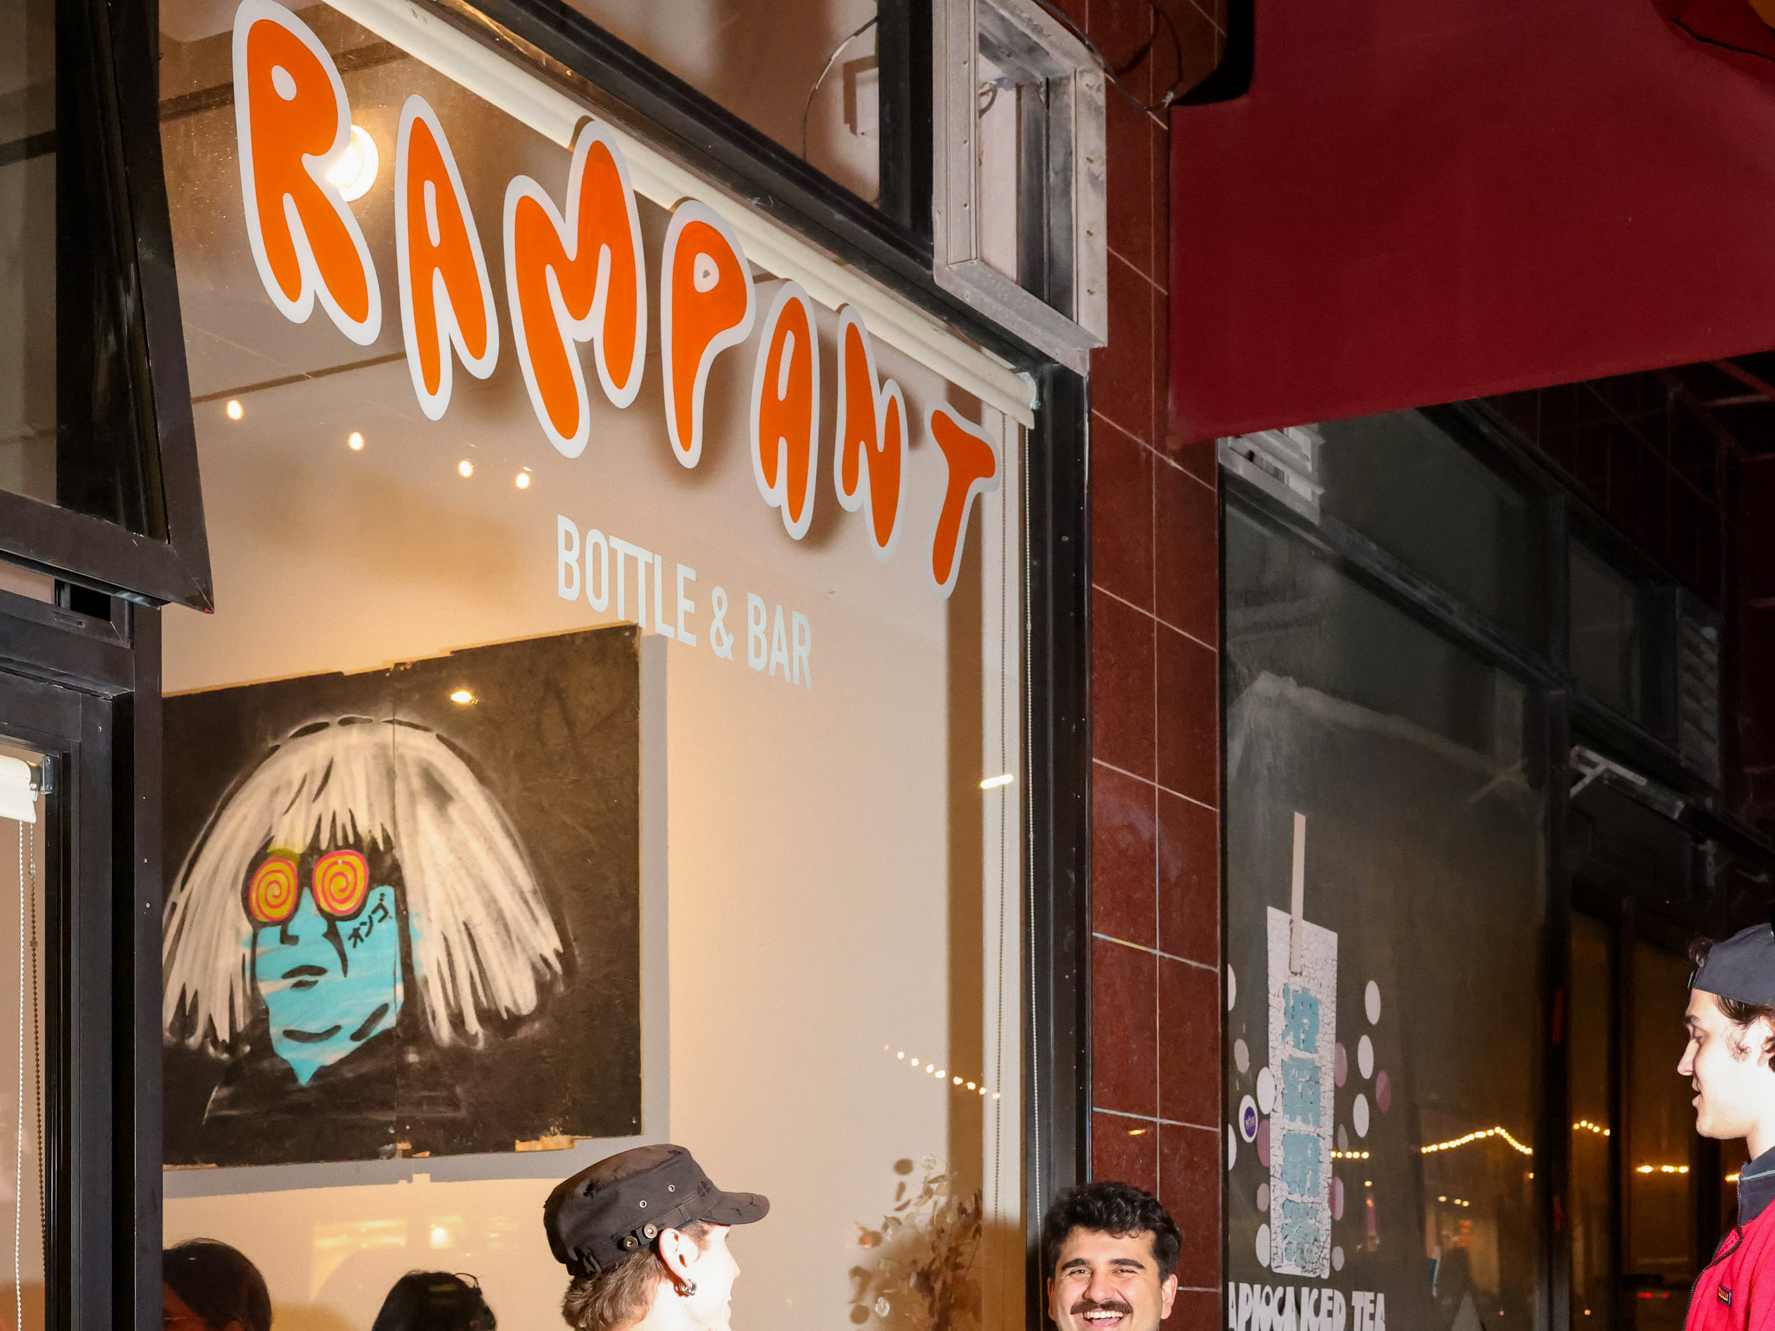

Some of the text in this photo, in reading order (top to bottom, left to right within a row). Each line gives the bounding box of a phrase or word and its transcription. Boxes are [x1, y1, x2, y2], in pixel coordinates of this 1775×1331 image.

[232, 0, 999, 600] RAMPANT
[557, 514, 812, 689] BOTTLE & BAR
